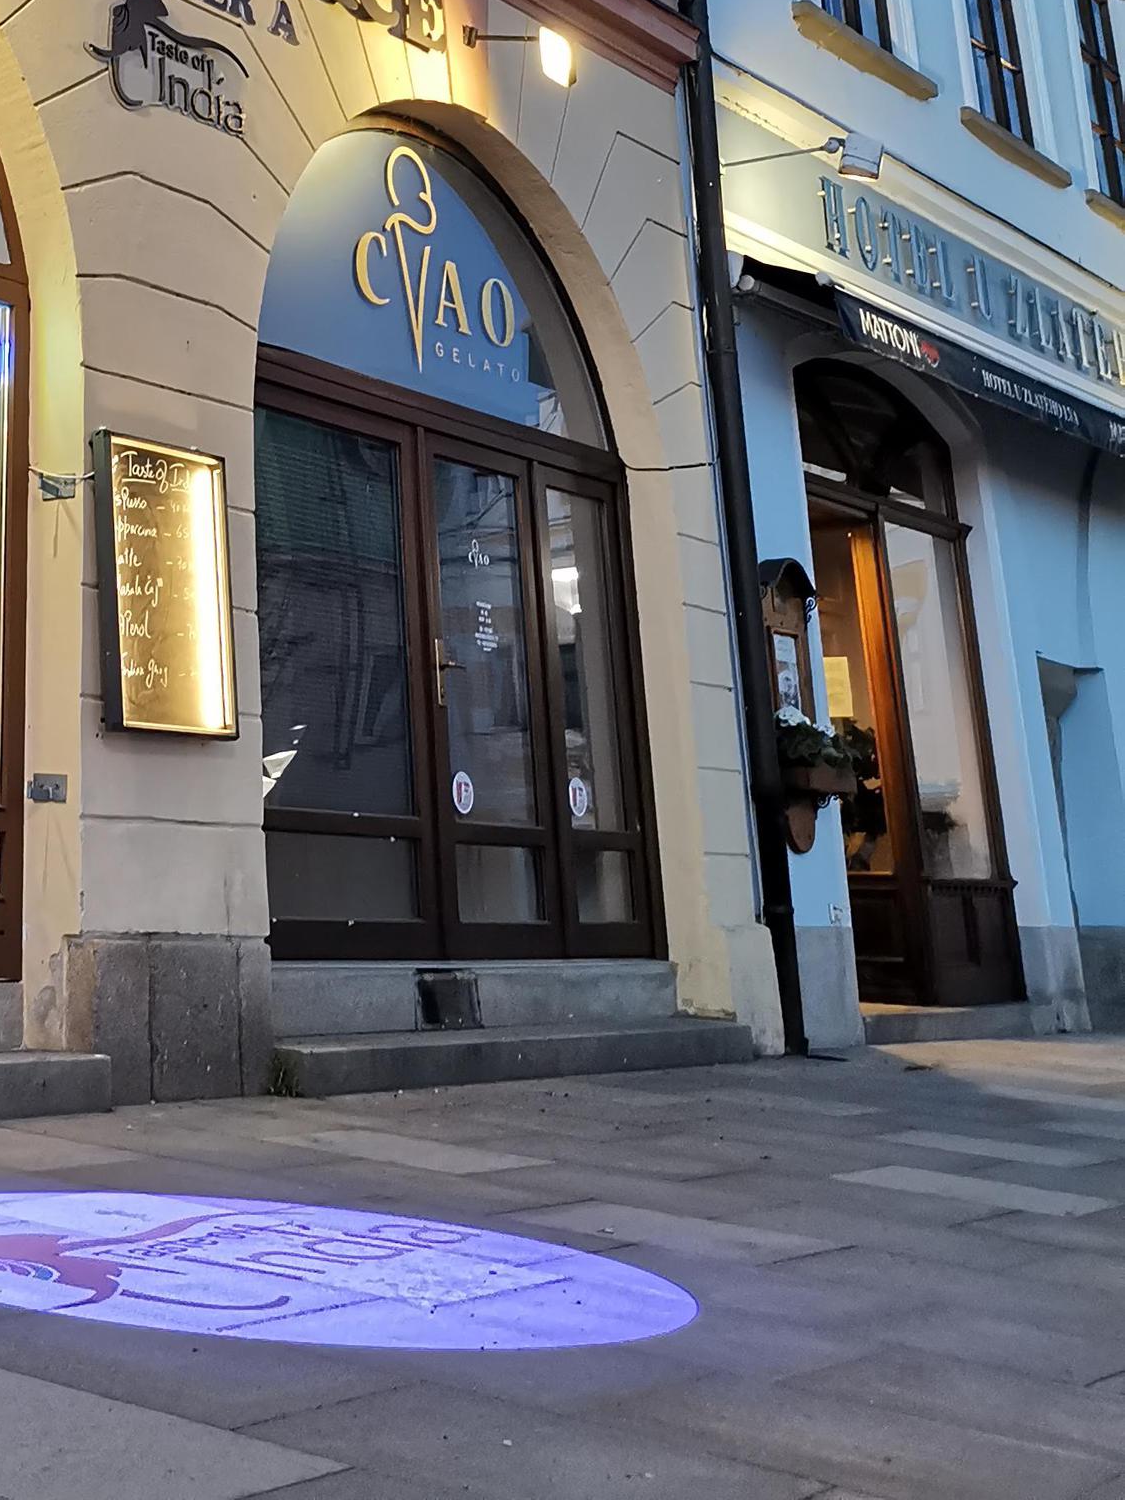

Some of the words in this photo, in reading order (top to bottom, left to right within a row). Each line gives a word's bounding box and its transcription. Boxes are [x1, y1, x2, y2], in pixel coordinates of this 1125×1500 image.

[147, 31, 189, 65] Taste
[191, 54, 208, 72] of
[859, 307, 921, 358] MATTONI
[434, 341, 520, 382] GELATO
[981, 369, 1015, 398] HOTEL
